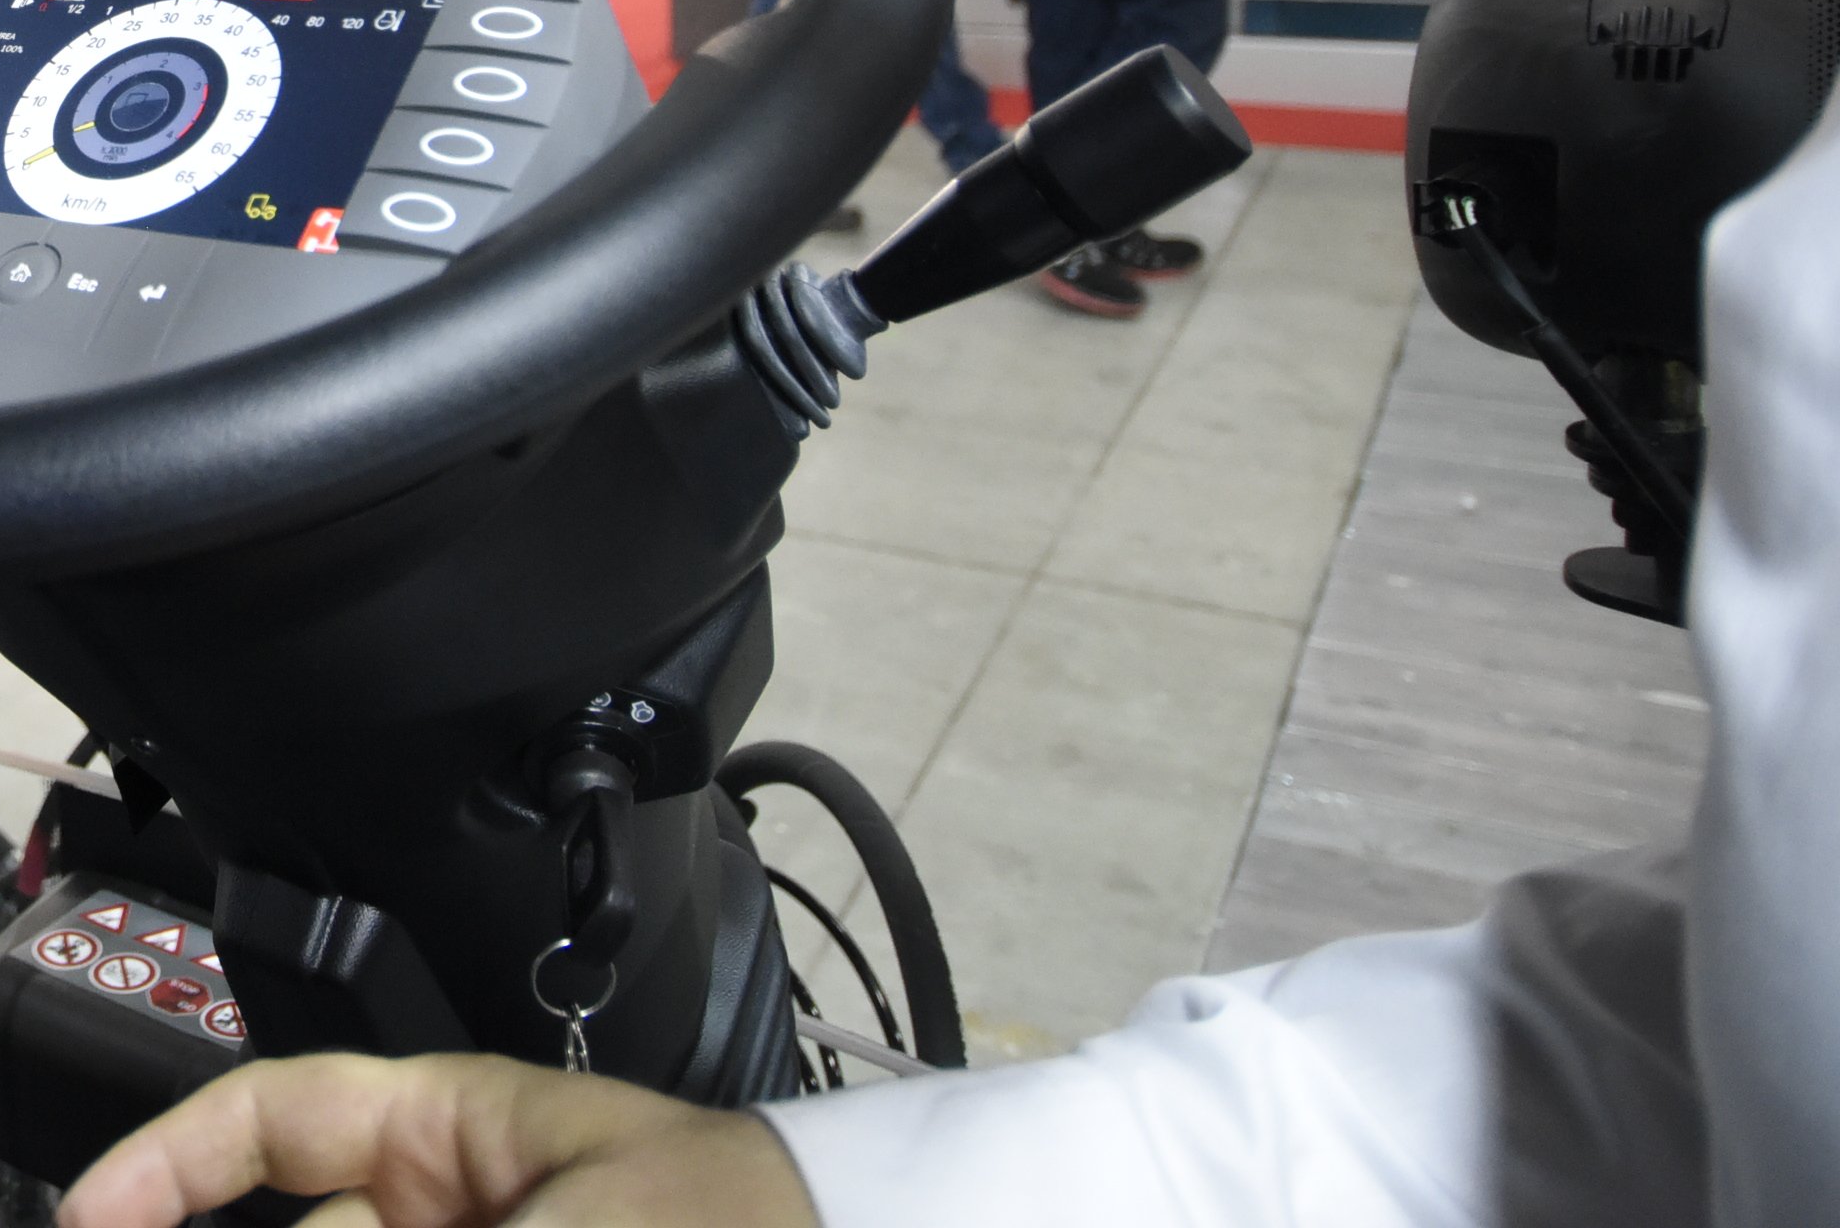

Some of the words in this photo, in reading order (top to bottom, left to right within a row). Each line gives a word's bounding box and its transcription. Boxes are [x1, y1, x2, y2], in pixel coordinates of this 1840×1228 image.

[67, 4, 86, 15] 1/2
[160, 12, 180, 24] 30
[194, 14, 214, 26] 35
[271, 14, 290, 26] 40
[305, 16, 325, 28] 80
[342, 18, 364, 30] 120
[123, 20, 144, 32] 25
[223, 24, 244, 37] 40
[0, 44, 24, 54] 100%
[86, 37, 106, 49] 20
[241, 46, 261, 58] 45
[55, 64, 71, 76] 15
[159, 59, 168, 69] 2
[193, 82, 202, 91] 3
[246, 75, 267, 87] 50
[32, 96, 47, 107] 10
[234, 109, 255, 122] 55
[20, 127, 30, 138] 5
[211, 142, 232, 155] 60
[175, 171, 195, 184] 65
[61, 194, 107, 211] km/h
[67, 272, 99, 292] Esc
